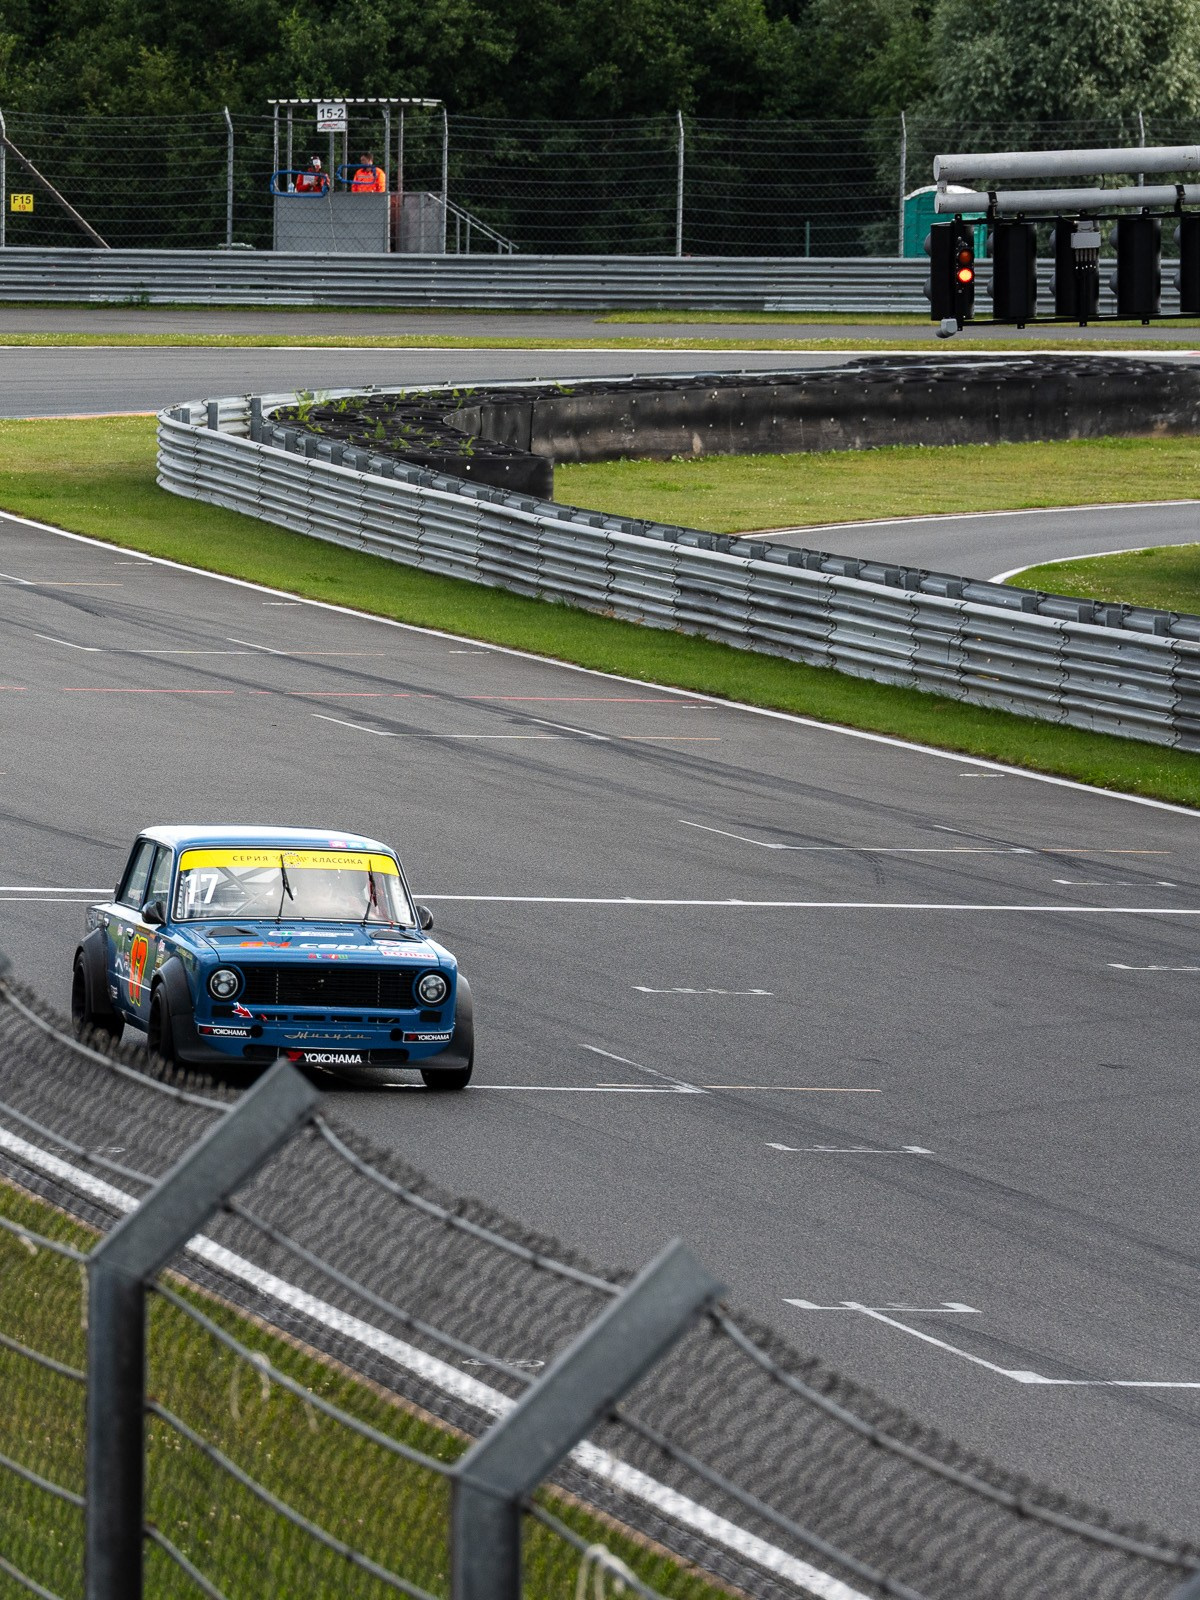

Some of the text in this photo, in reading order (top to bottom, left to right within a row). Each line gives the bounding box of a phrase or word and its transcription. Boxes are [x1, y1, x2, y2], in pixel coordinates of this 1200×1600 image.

[320, 108, 344, 119] 15-2
[13, 195, 32, 204] F15
[312, 857, 364, 865] КЛАССИКА
[185, 873, 219, 904] 17
[129, 934, 149, 1007] 17
[212, 1027, 248, 1036] YOKOHAMA
[417, 1033, 450, 1041] YOKOHAMA
[304, 1052, 363, 1064] YOKOHAMA
